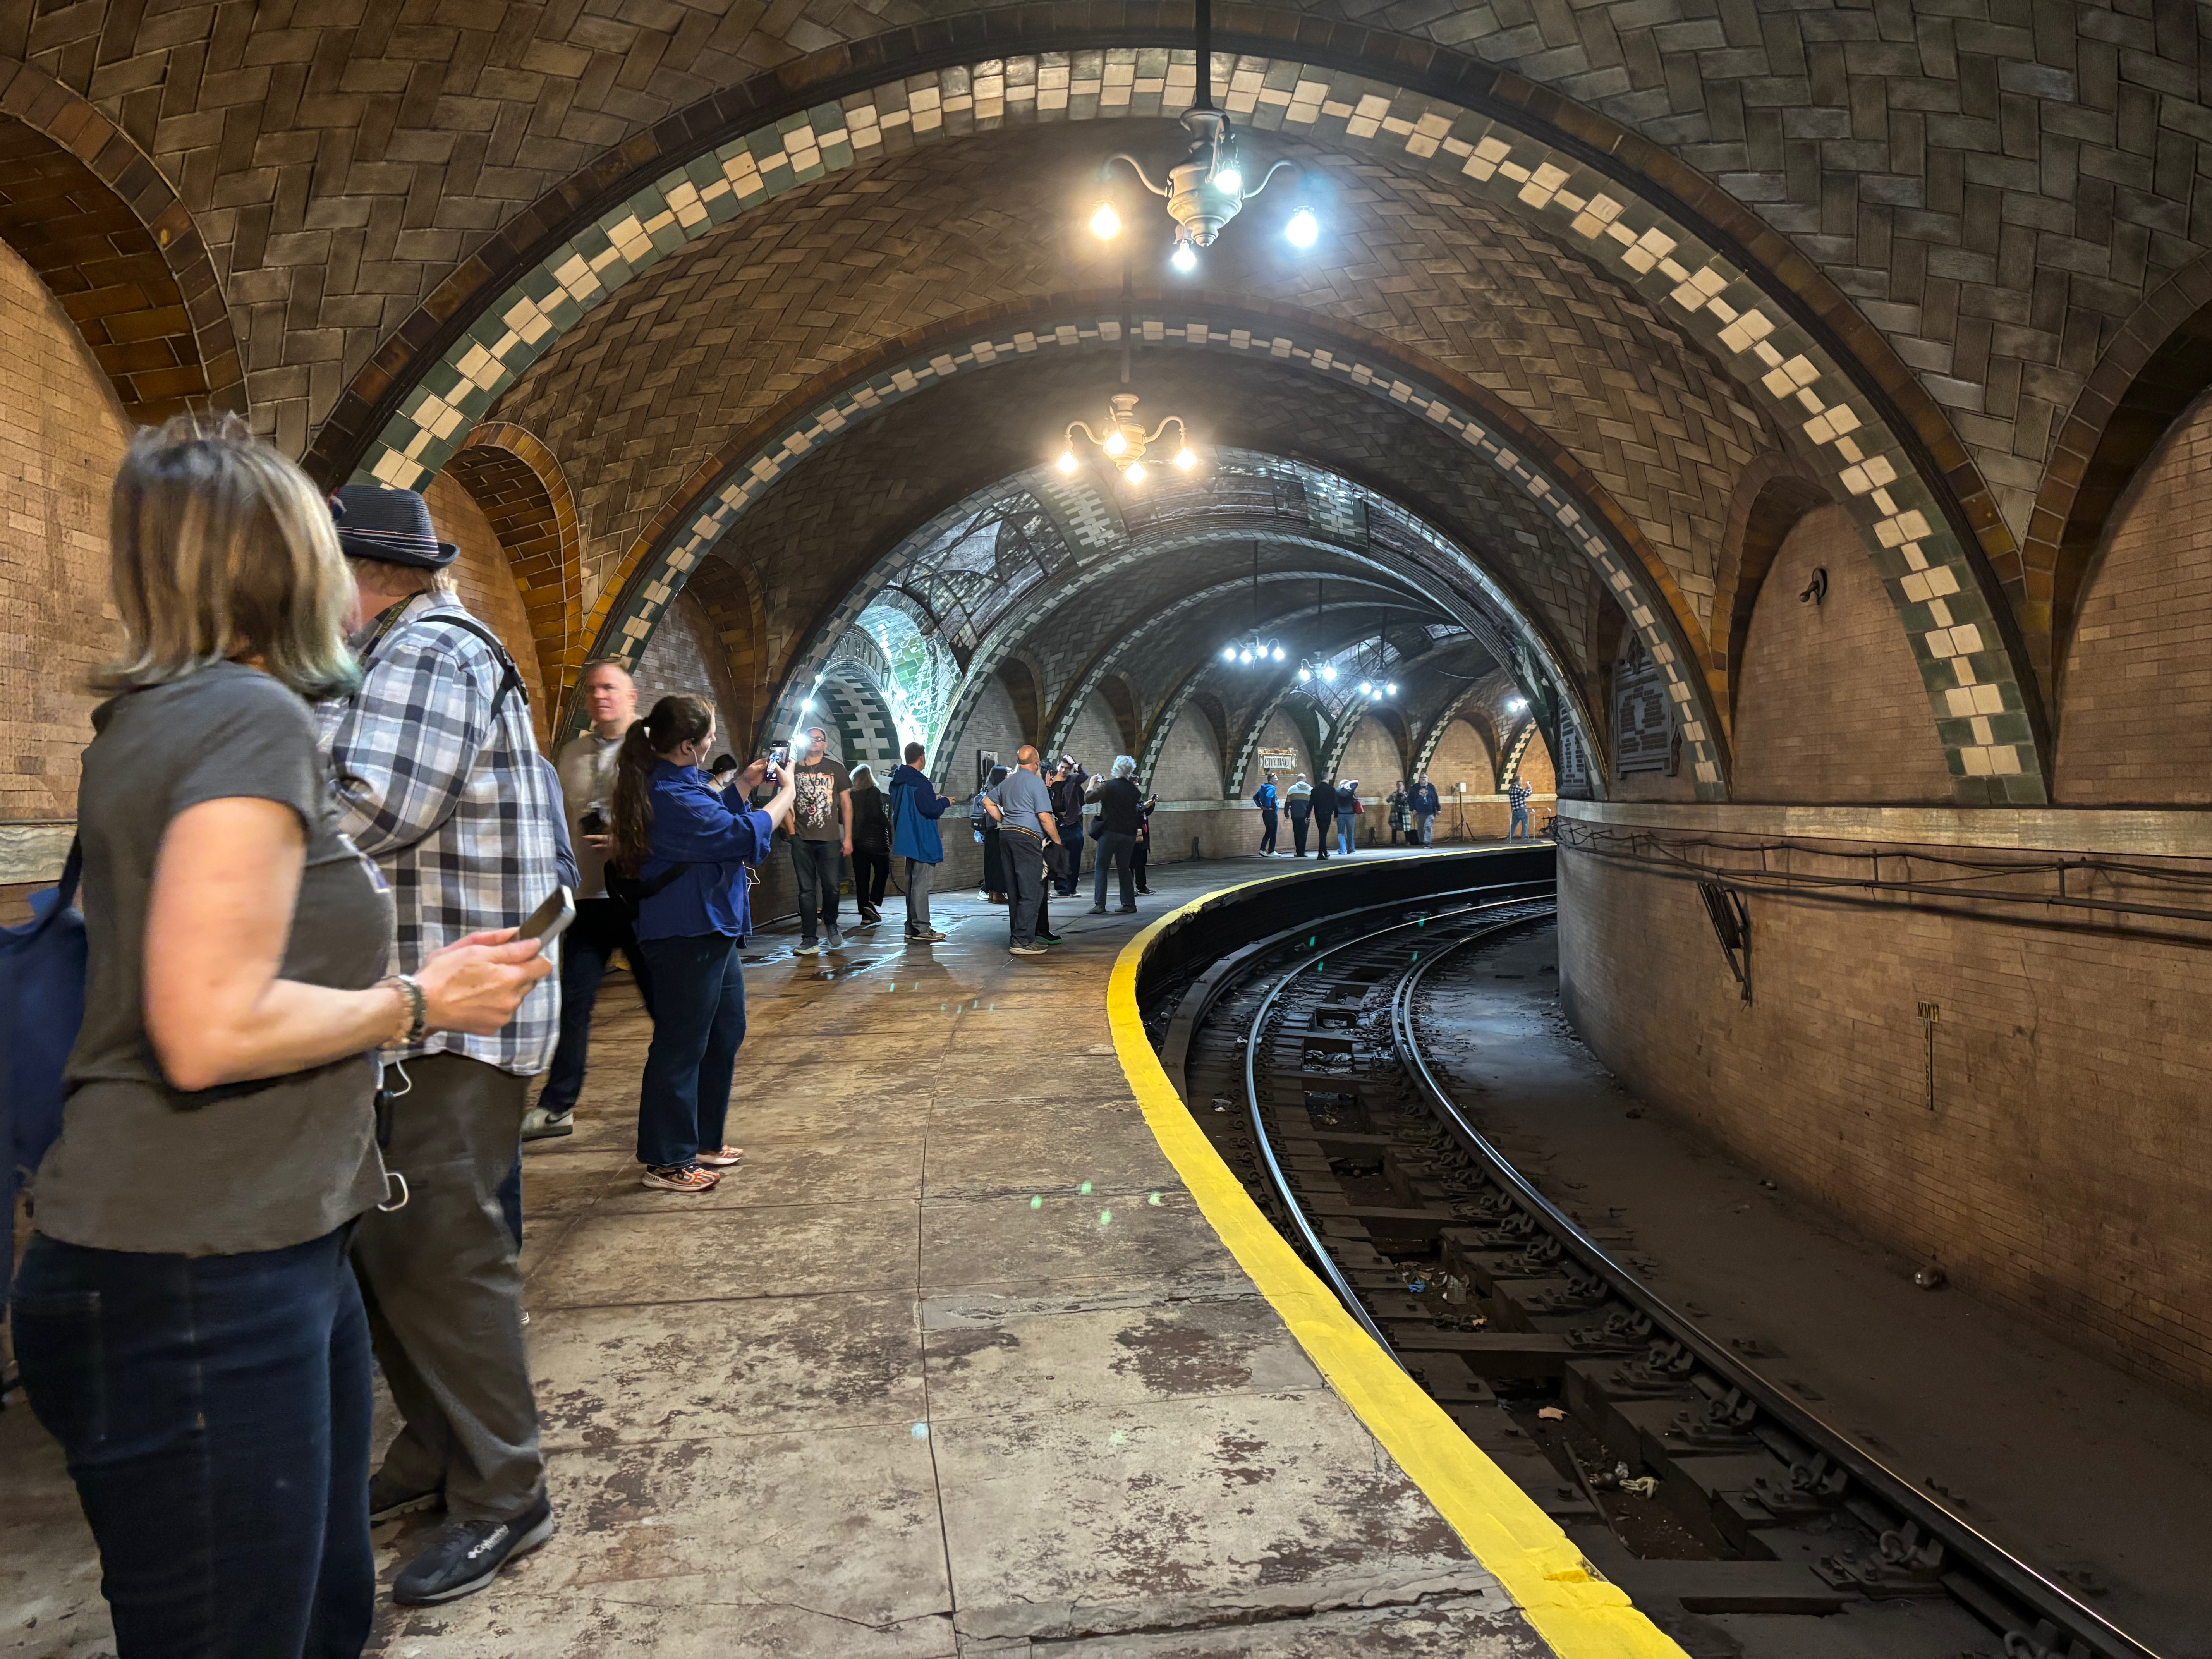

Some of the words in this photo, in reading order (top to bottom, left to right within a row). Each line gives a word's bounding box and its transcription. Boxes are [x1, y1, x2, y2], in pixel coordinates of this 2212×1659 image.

[854, 638, 880, 677] HALL
[1265, 757, 1277, 767] CITY
[1277, 757, 1291, 767] HALL
